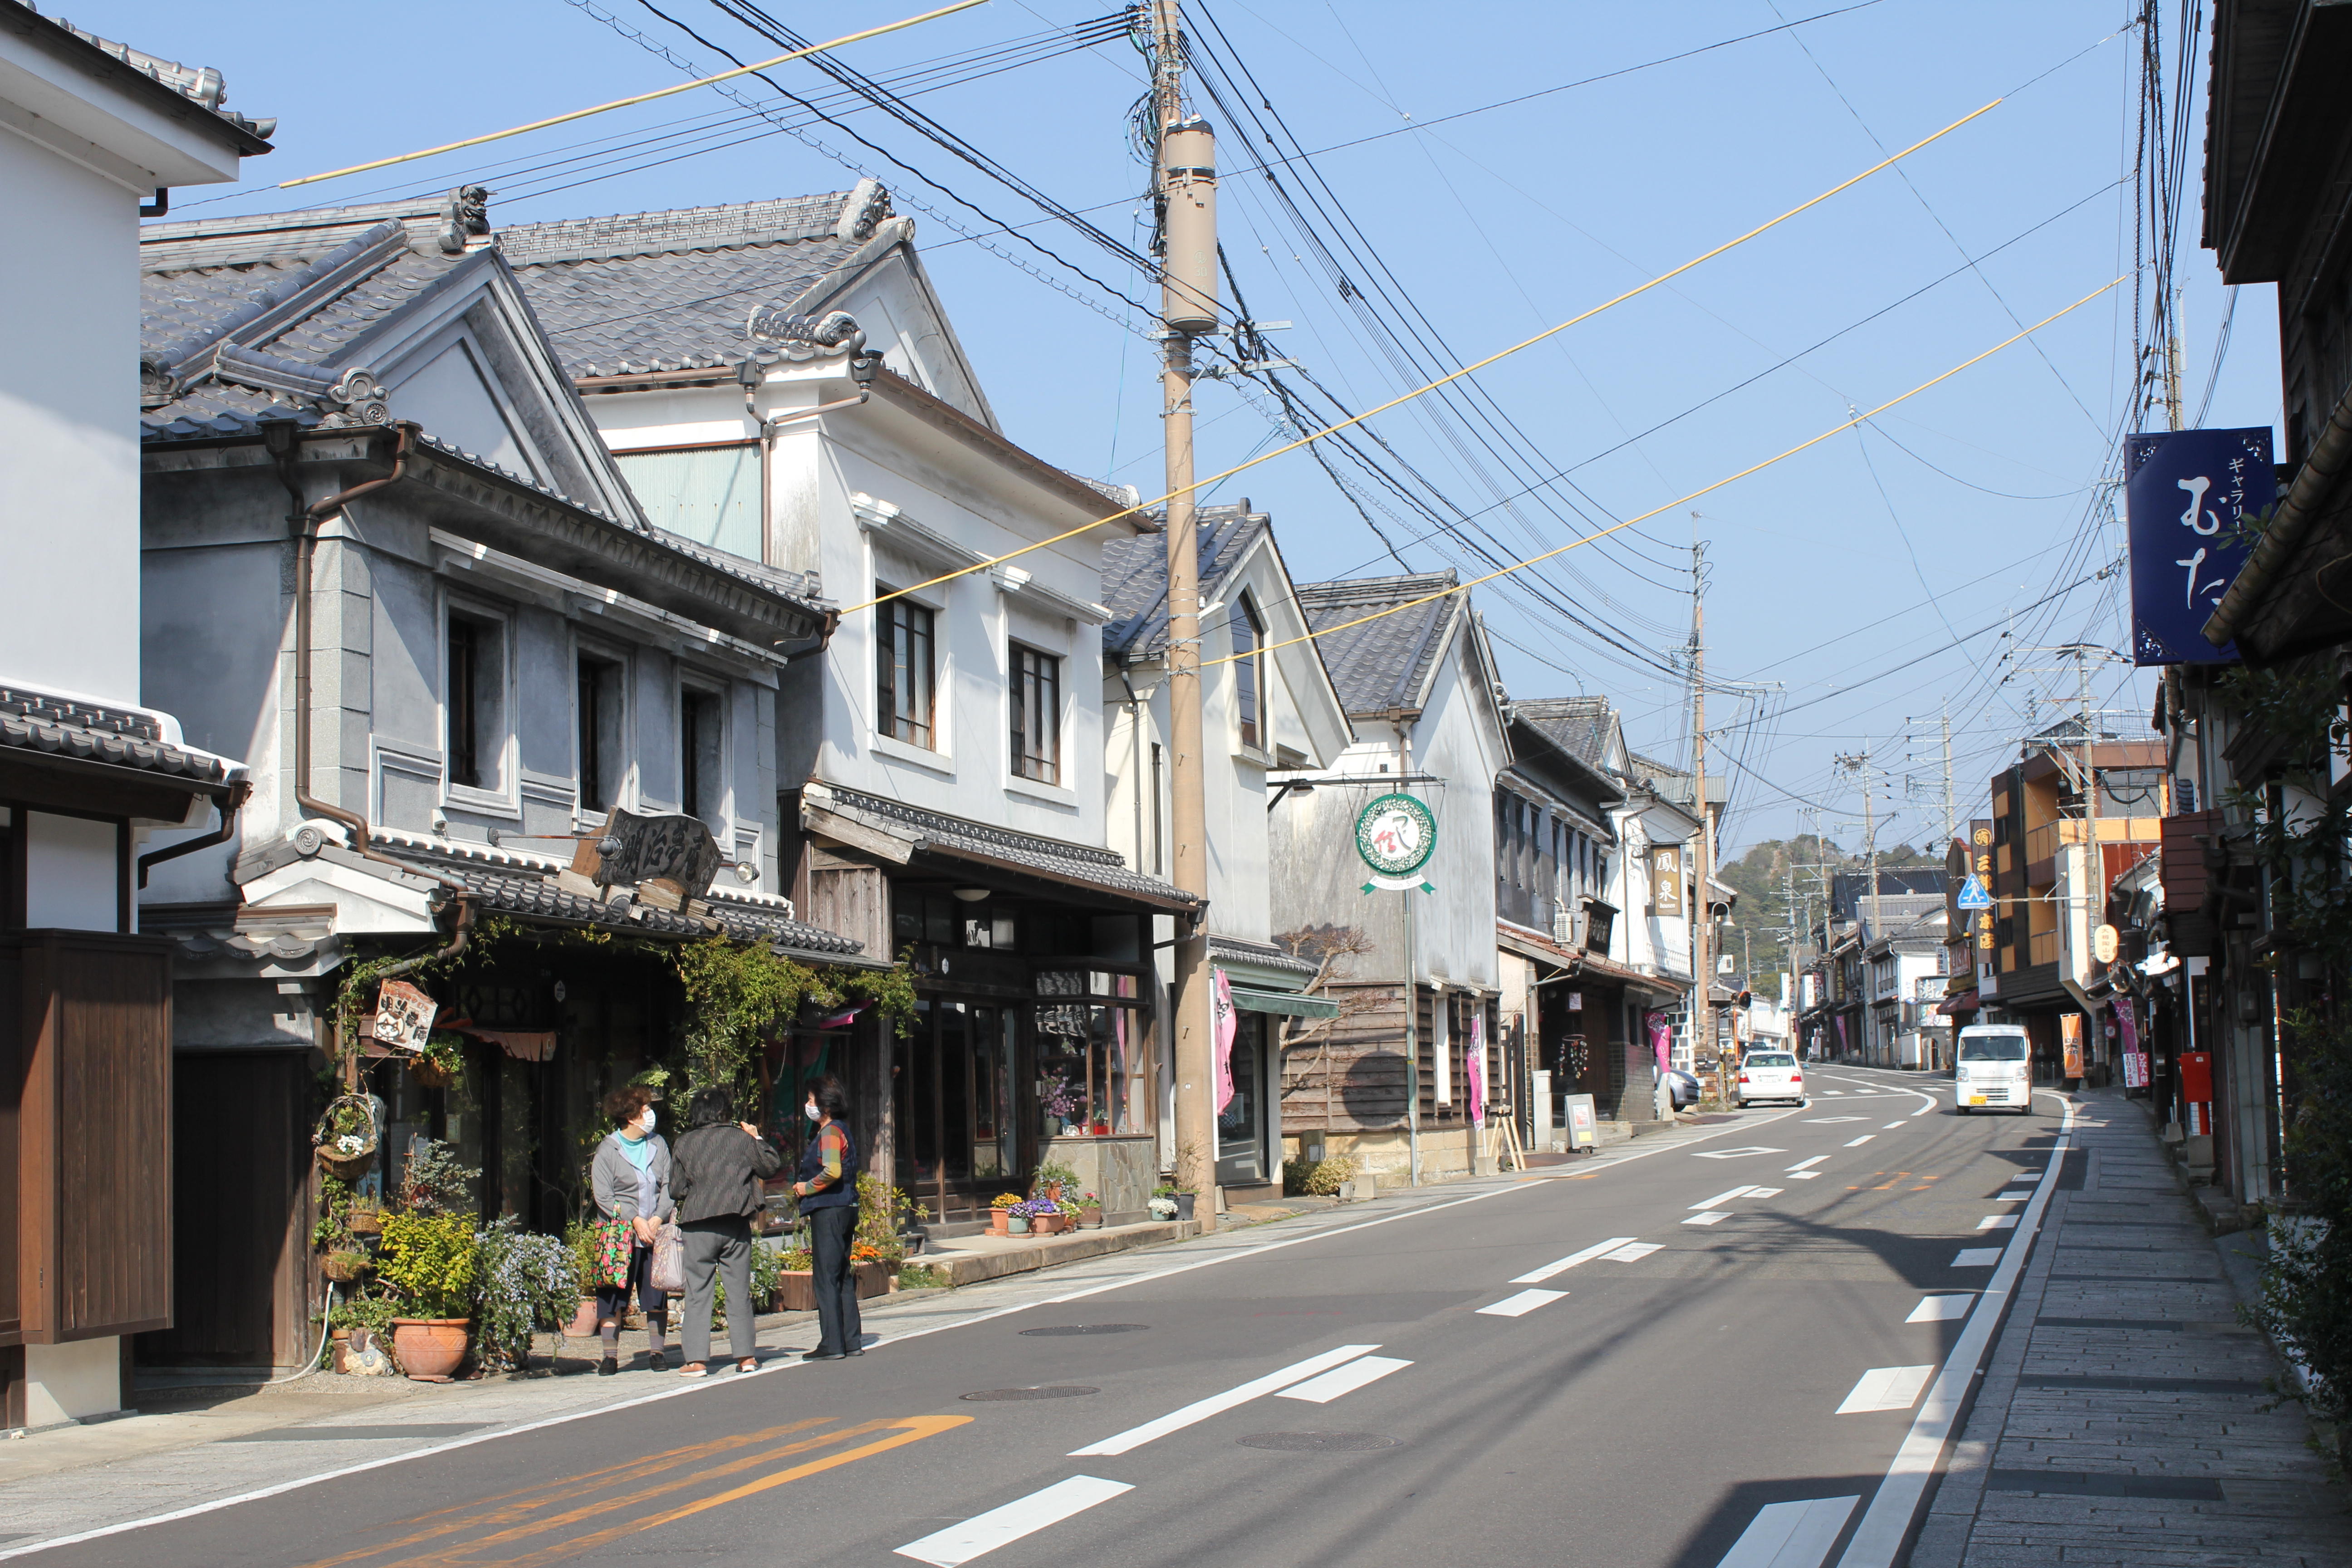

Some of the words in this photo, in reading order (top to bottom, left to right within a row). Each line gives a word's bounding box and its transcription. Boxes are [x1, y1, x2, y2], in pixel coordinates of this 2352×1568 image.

[2176, 476, 2227, 610] むた
[1372, 877, 1403, 889] Porcelain
[1406, 876, 1423, 887] Shop
[1656, 852, 1678, 902] 鳳泉
[2138, 1053, 2148, 1083] ひな人形
